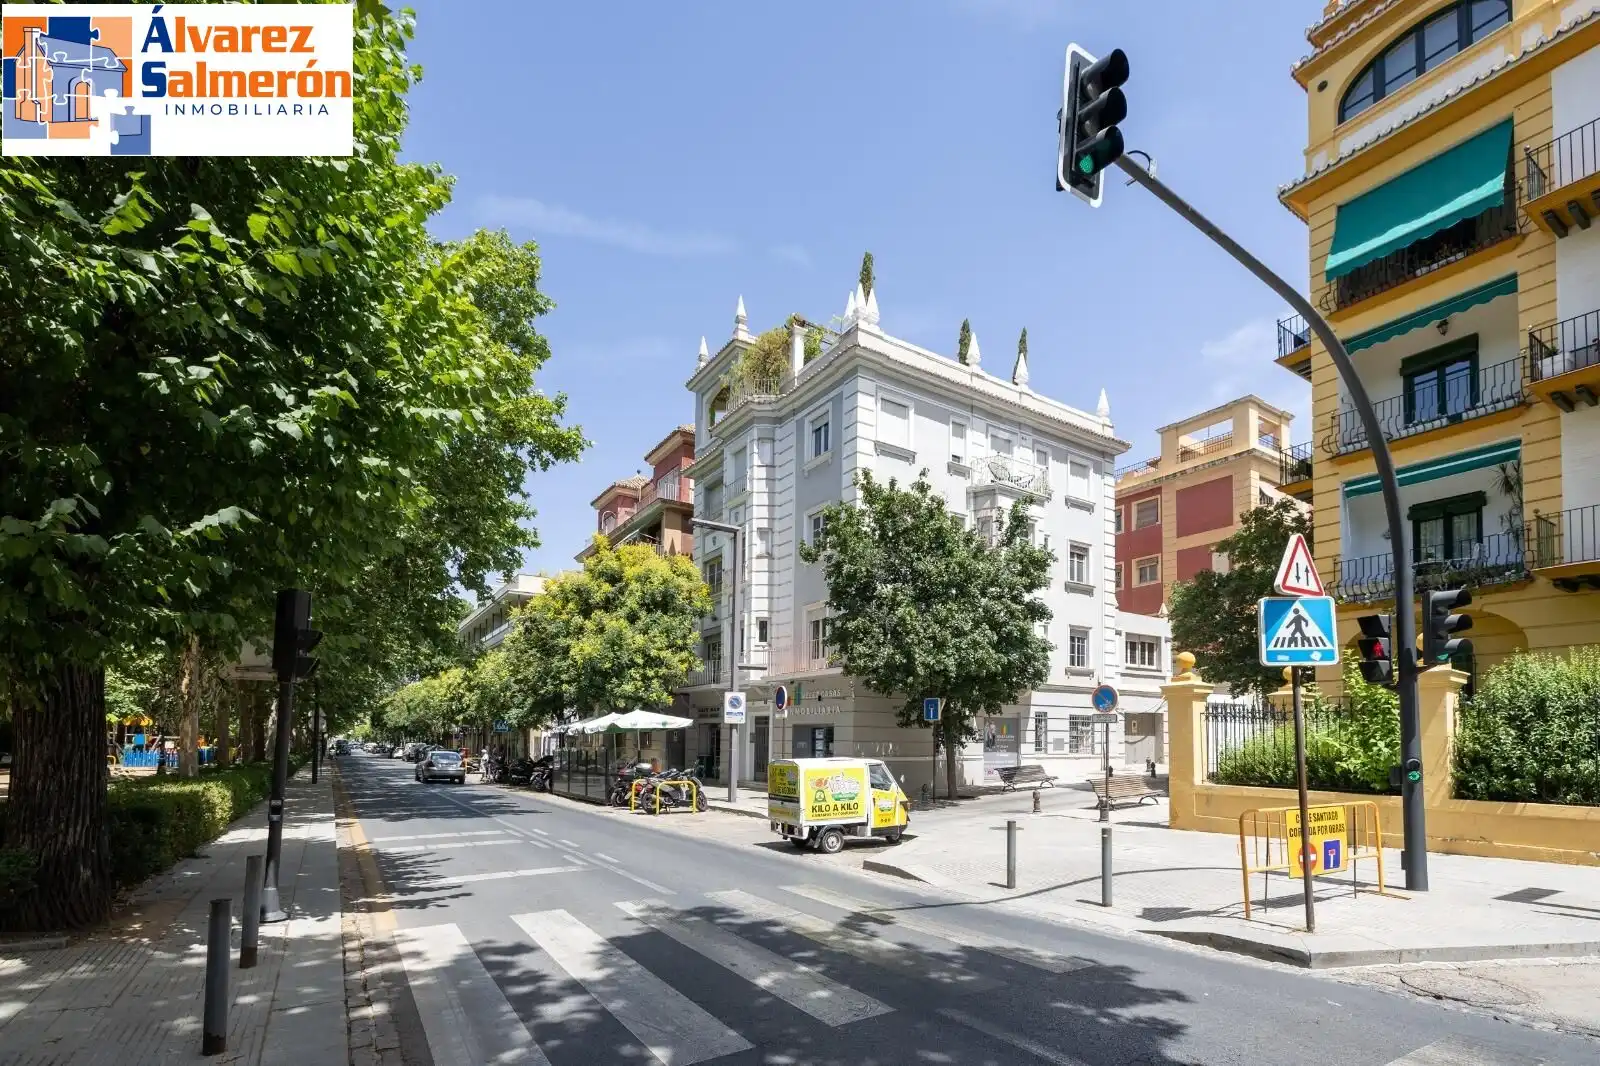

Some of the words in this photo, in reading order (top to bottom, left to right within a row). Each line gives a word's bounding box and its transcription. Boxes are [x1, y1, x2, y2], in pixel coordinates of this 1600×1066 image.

[811, 804, 830, 813] KILO
[832, 803, 839, 812] A
[840, 802, 859, 812] KILO
[1313, 811, 1339, 822] SANTIAGO
[1289, 826, 1317, 838] CORDA
[1317, 825, 1328, 835] POR
[1329, 824, 1345, 834] OBRAS
